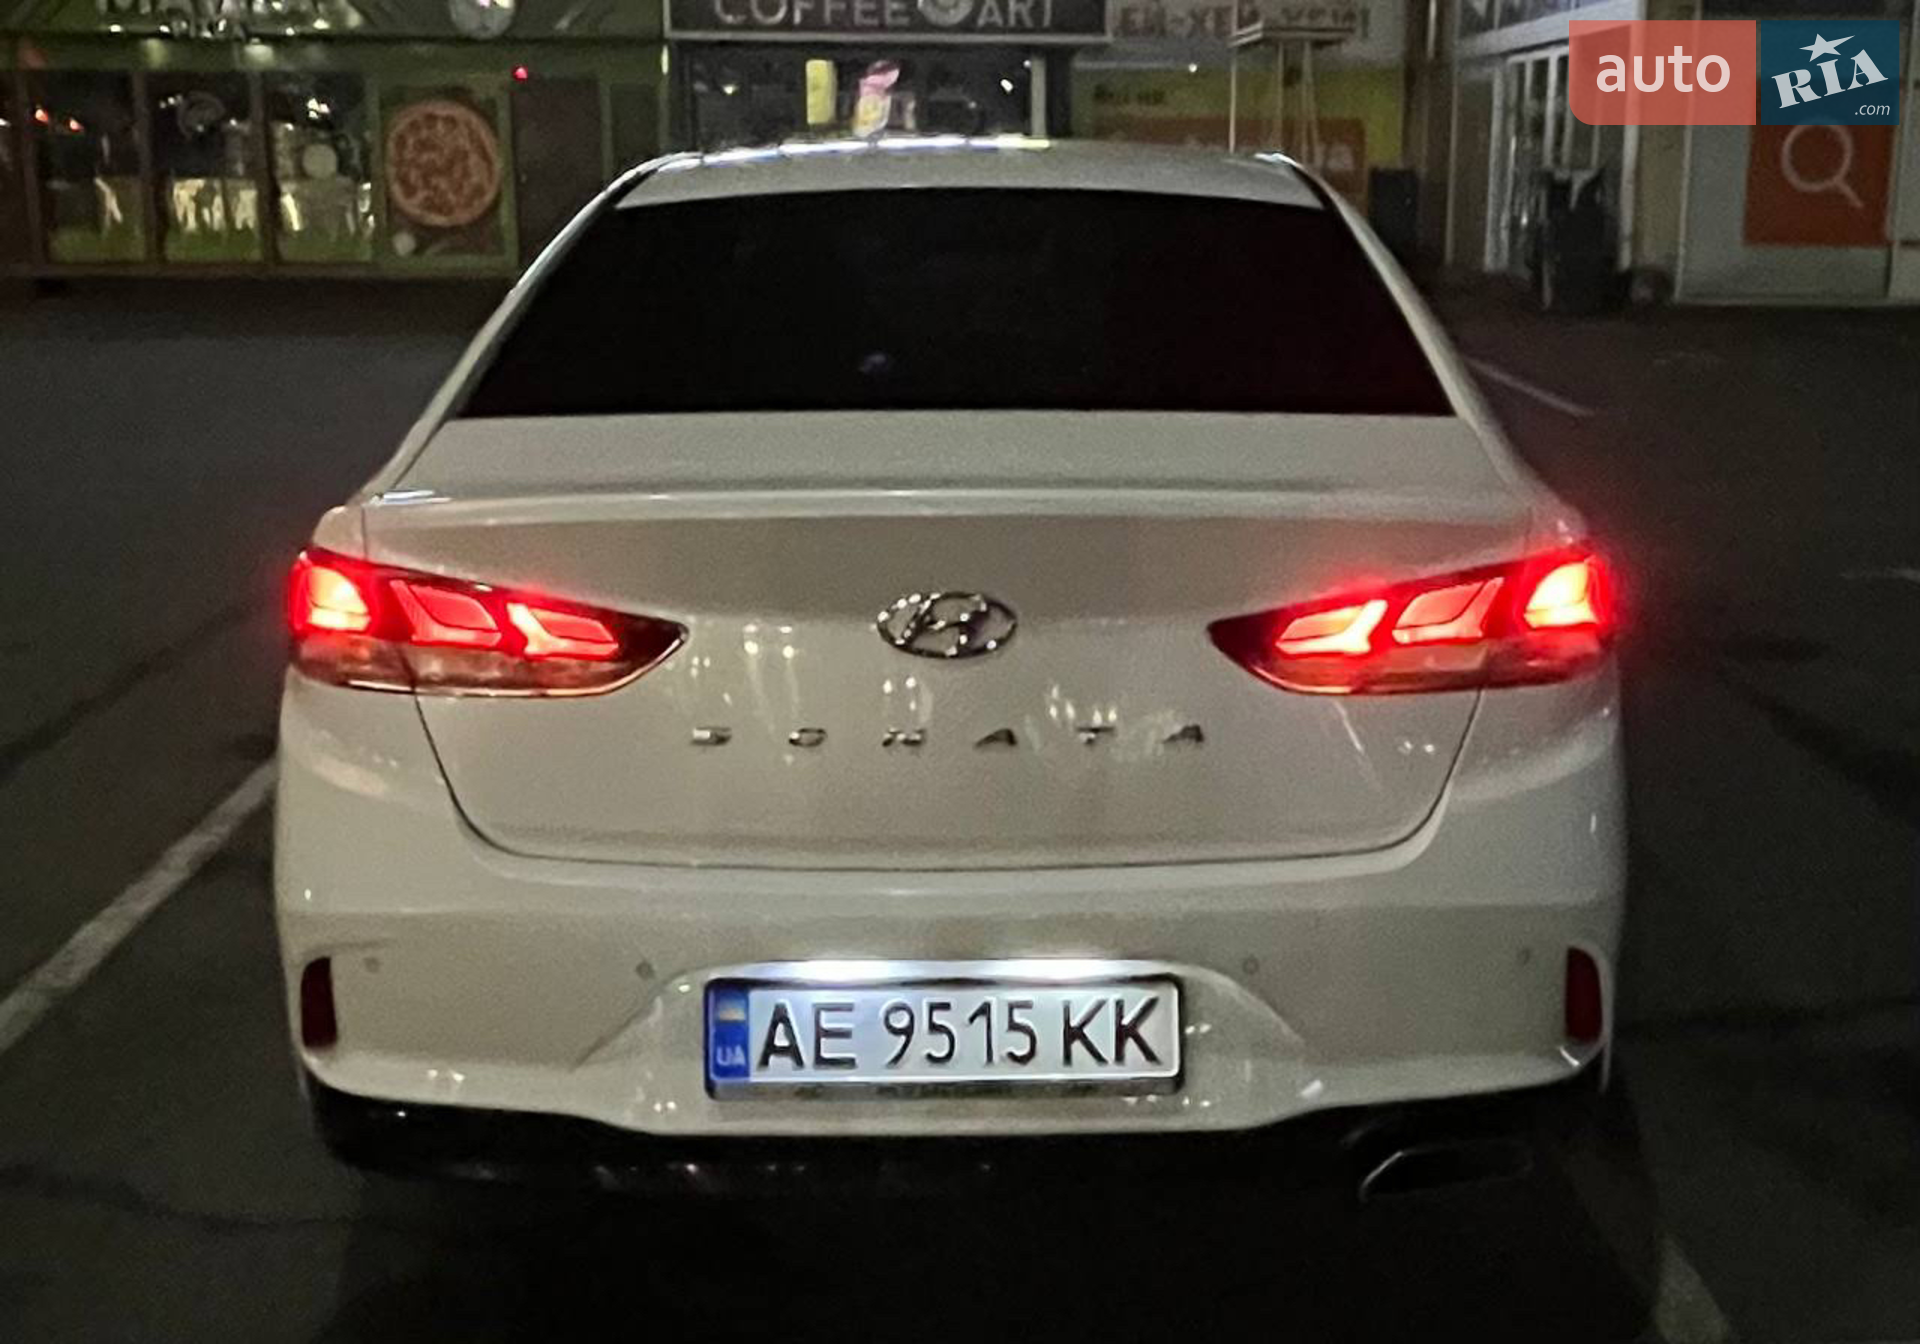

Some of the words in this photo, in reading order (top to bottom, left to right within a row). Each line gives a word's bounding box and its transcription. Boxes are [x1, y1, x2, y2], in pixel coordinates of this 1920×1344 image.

[714, 0, 909, 25] COFFEE
[757, 1002, 856, 1068] AE
[884, 1000, 1037, 1067] 9515
[1063, 998, 1163, 1067] KK
[717, 1046, 747, 1067] UA
